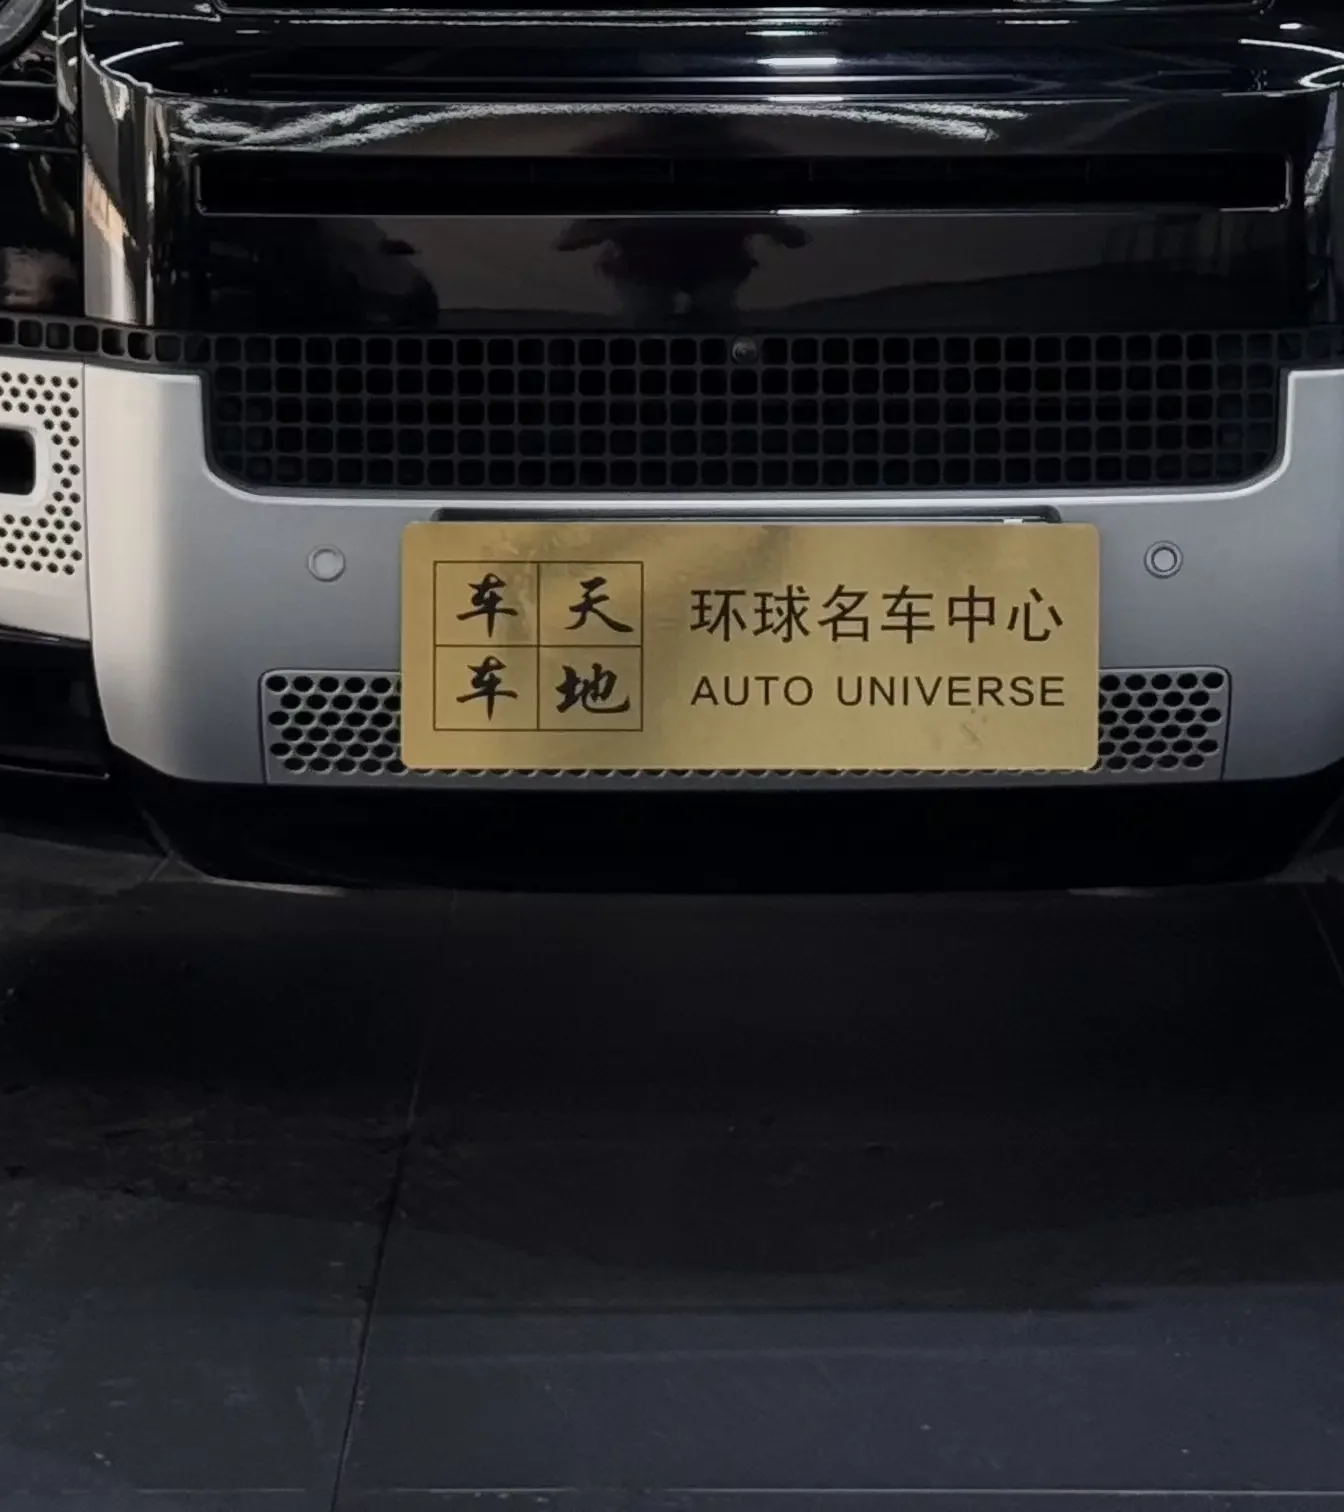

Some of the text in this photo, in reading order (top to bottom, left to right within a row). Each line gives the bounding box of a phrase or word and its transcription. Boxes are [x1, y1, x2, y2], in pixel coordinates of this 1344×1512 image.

[690, 585, 1062, 644] 环球名车中心
[691, 676, 1064, 706] AUTO UNIVERSE
